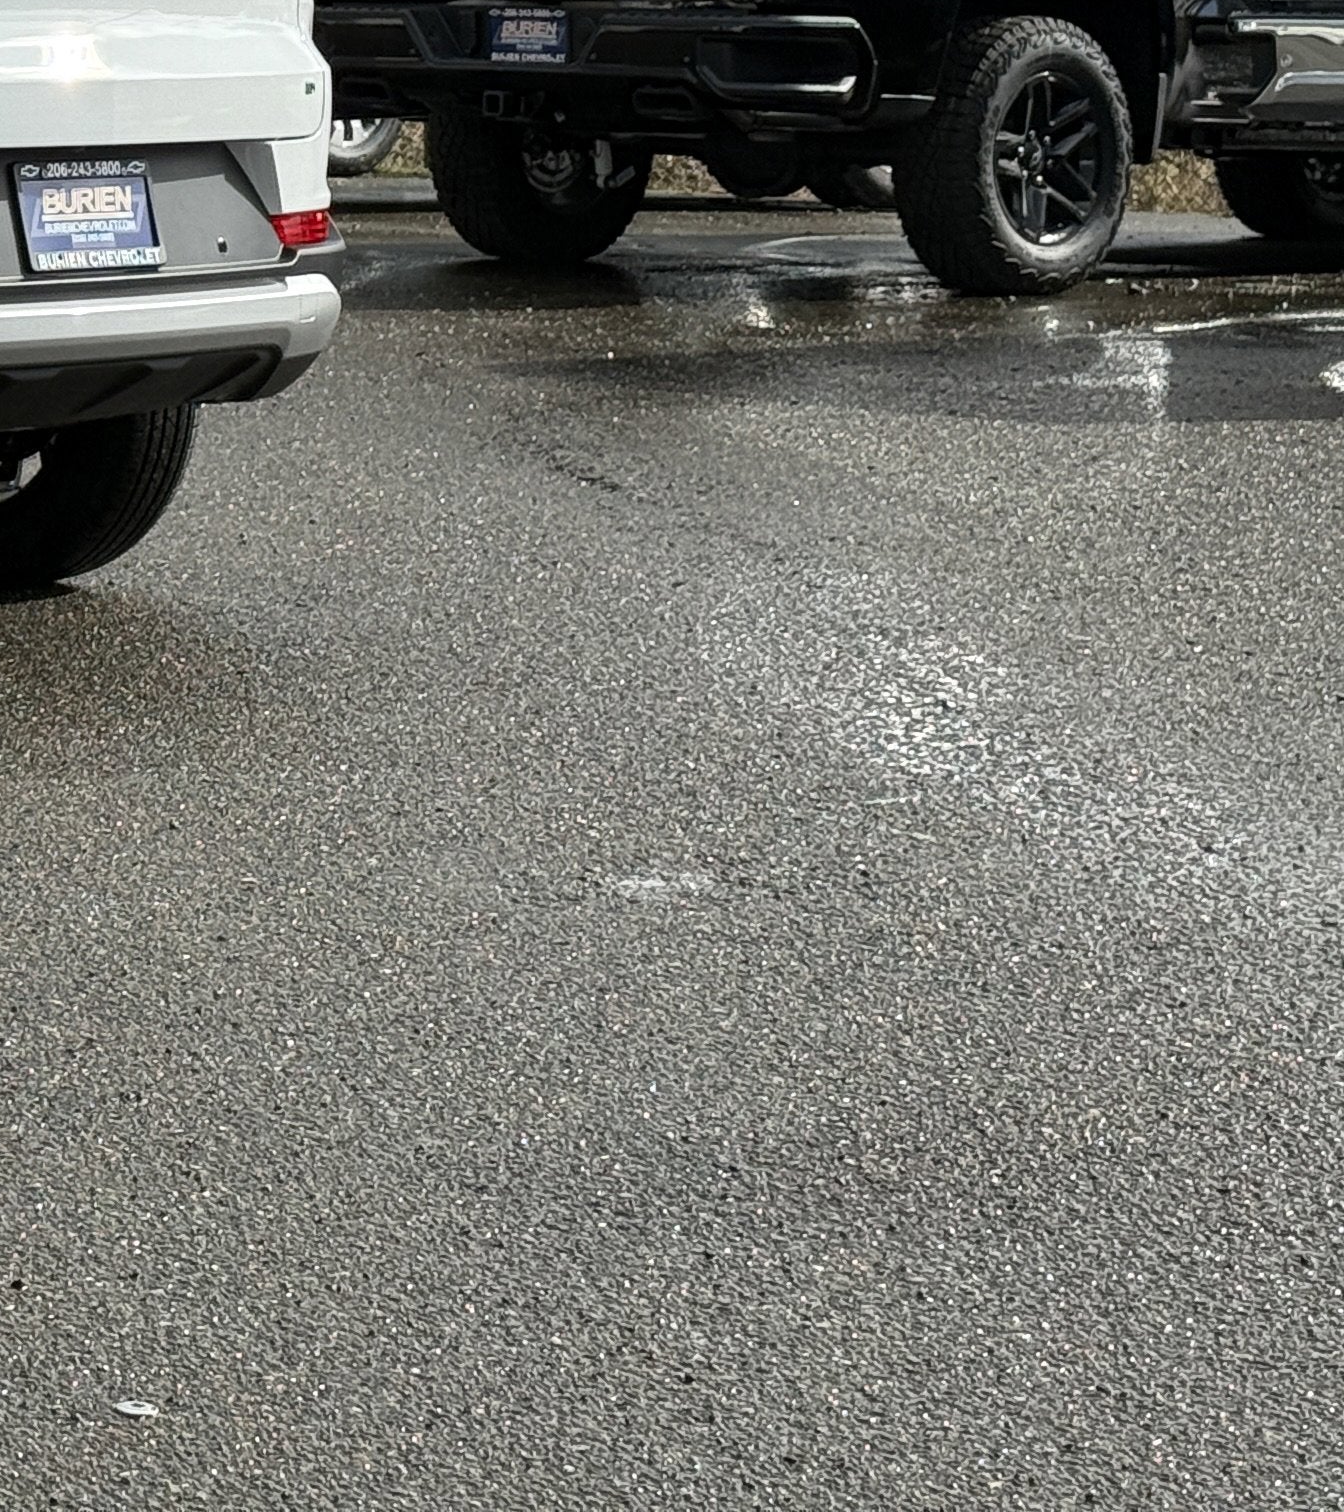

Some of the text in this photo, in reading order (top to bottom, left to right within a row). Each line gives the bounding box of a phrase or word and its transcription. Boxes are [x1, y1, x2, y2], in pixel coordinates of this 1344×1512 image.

[501, 20, 558, 35] BURIEN
[46, 160, 121, 178] 206-243-5800
[42, 185, 132, 214] BURIEN
